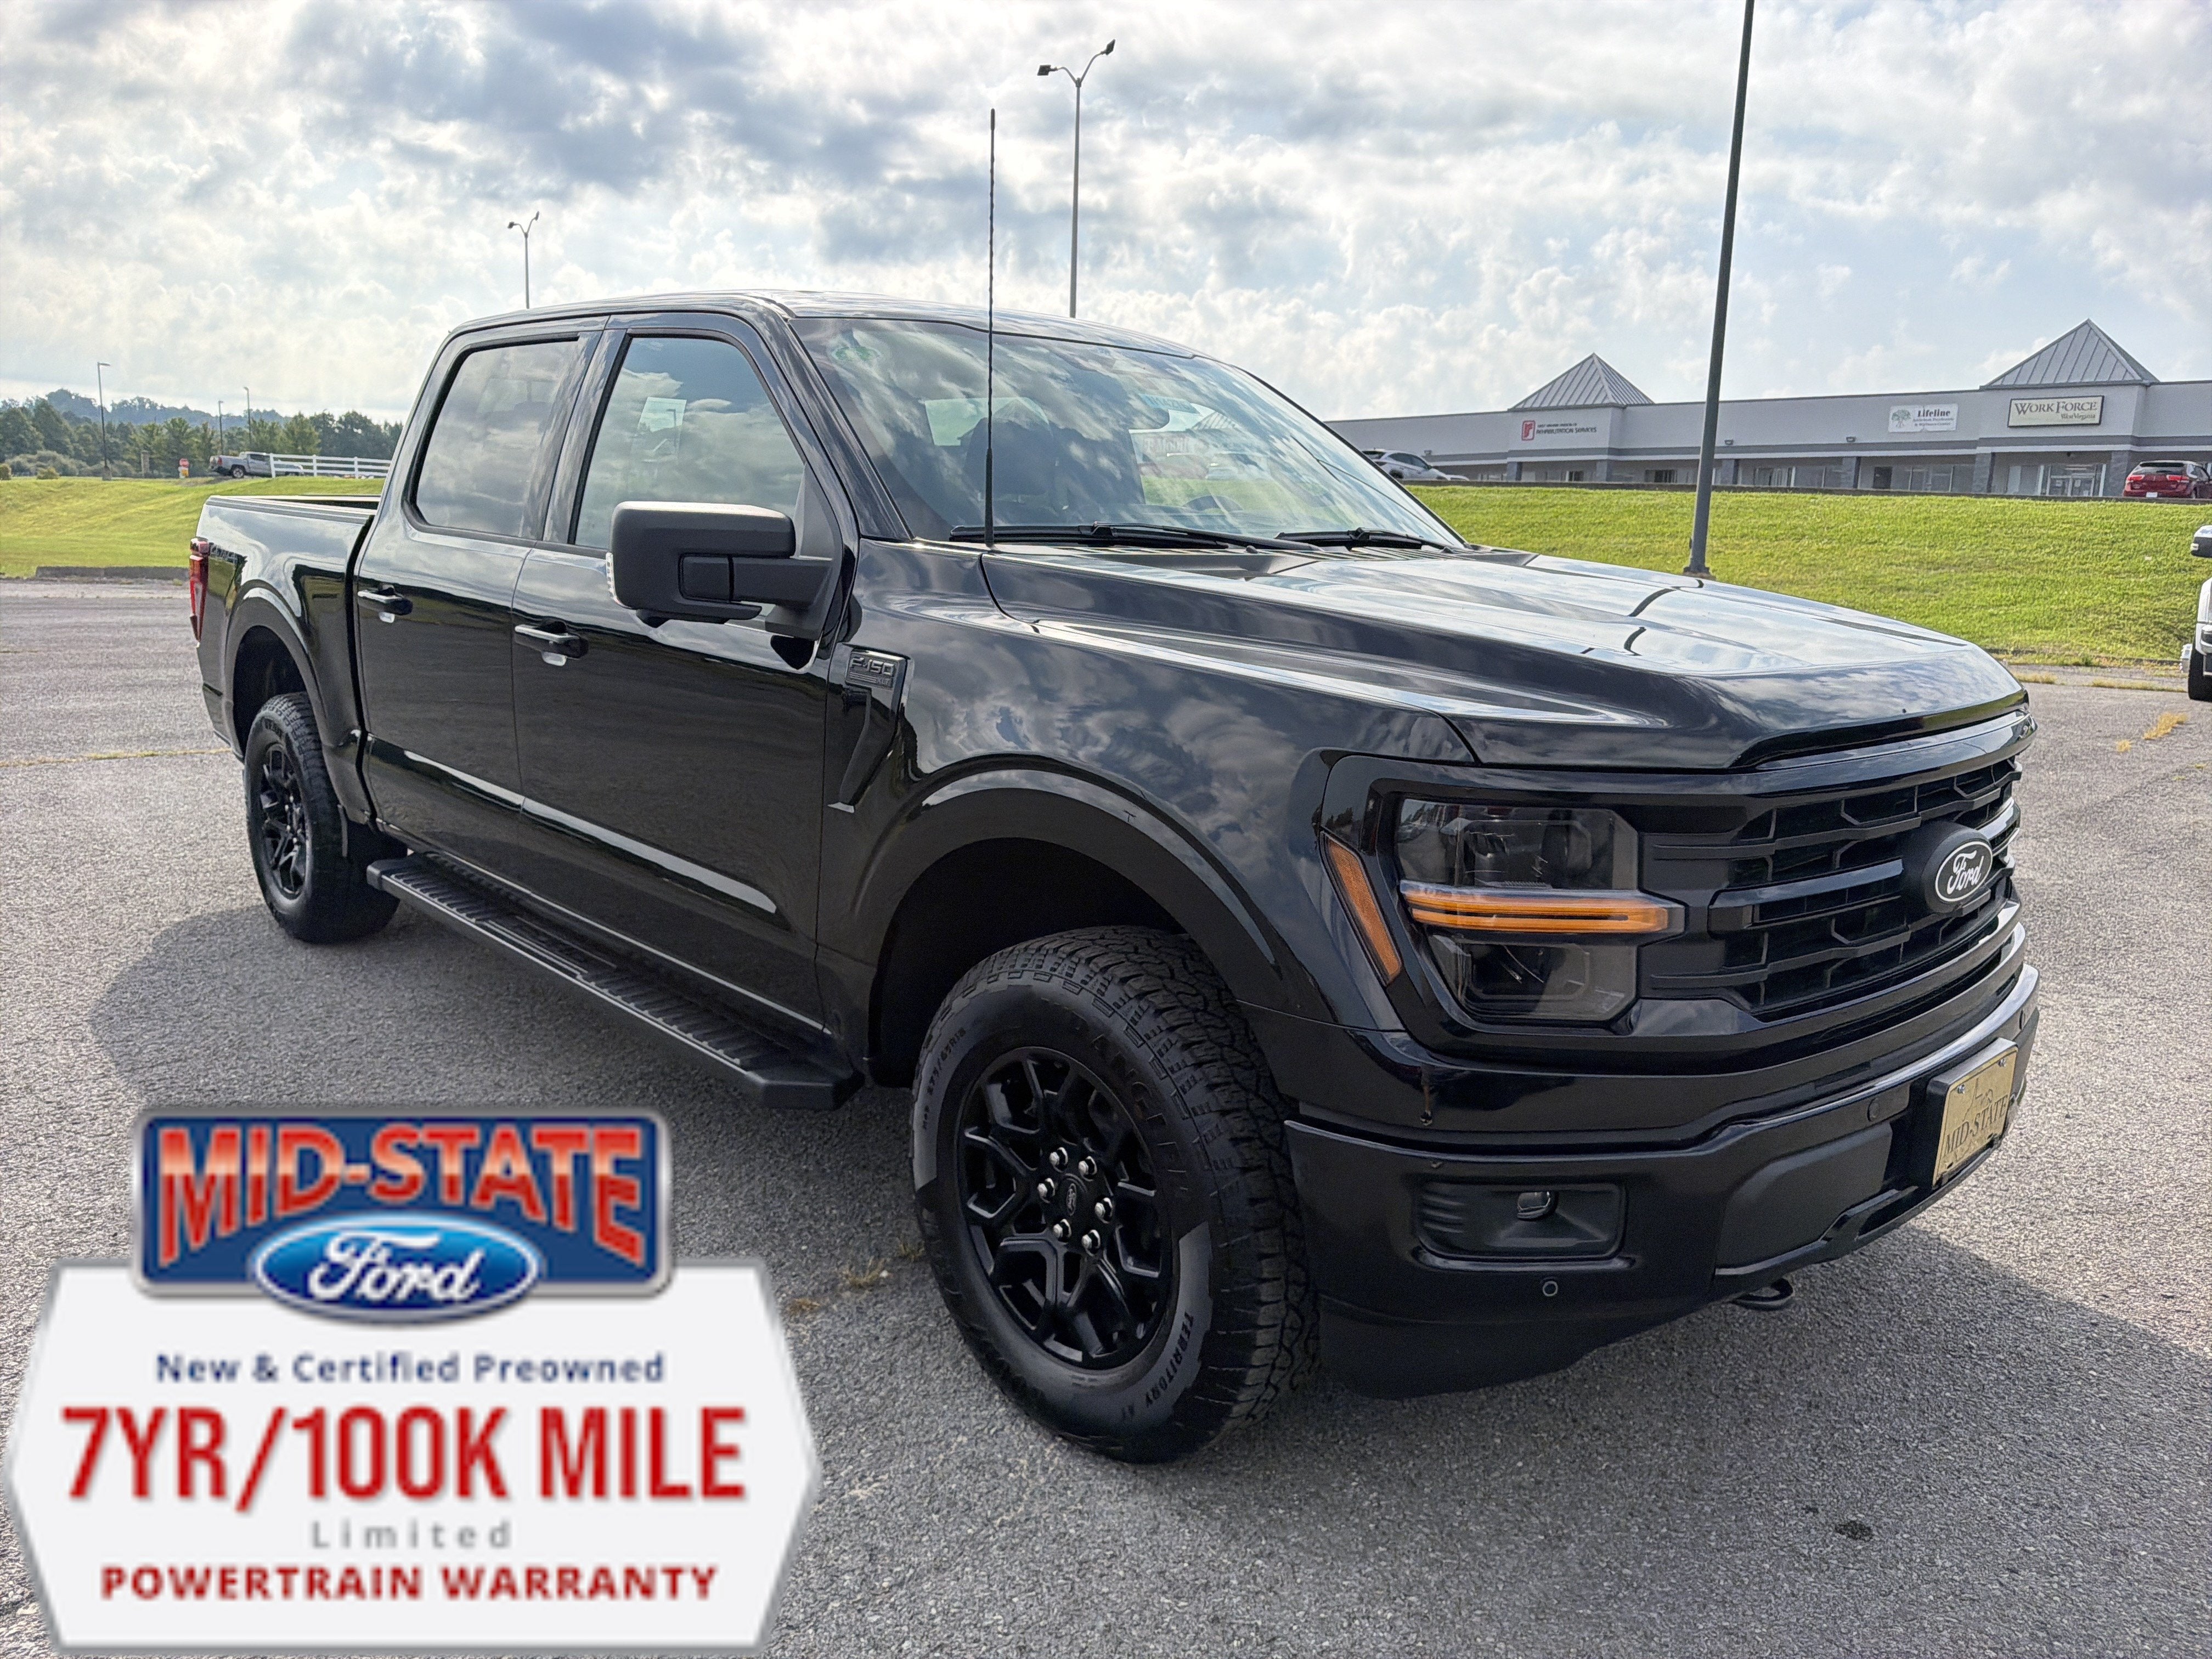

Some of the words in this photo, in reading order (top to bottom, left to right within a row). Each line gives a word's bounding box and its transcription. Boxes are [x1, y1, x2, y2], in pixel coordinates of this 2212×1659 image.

[1917, 408, 1951, 417] Lifeline
[1946, 850, 1984, 895] Ford
[1145, 1311, 1194, 1408] TERRITORY
